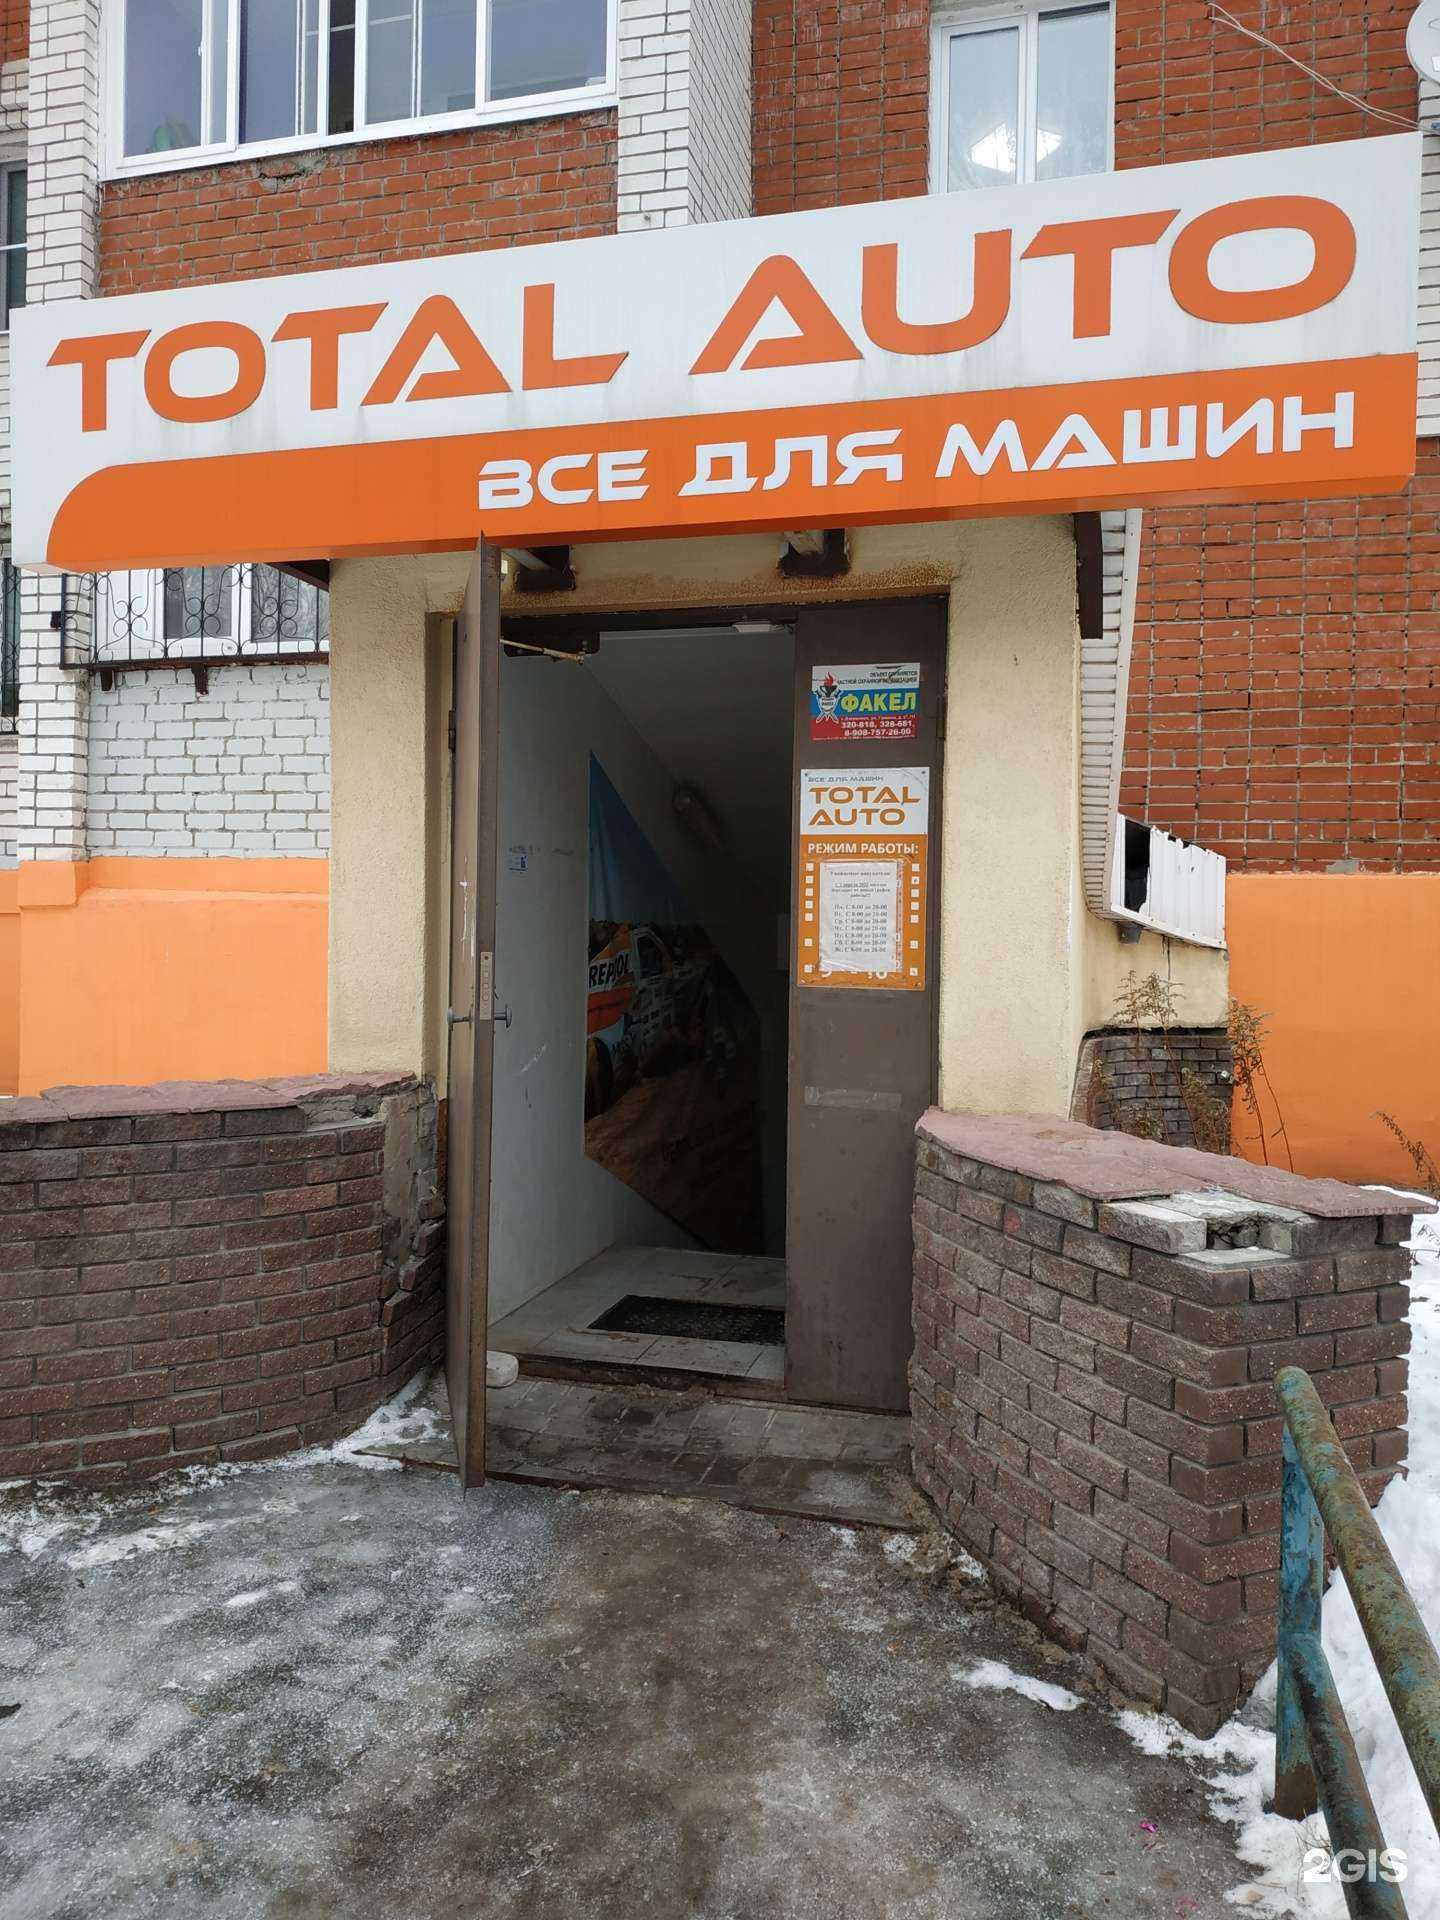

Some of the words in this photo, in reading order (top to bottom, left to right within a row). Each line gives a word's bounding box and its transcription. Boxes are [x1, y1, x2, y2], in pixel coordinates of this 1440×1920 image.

[46, 282, 629, 432] TOTAL
[688, 194, 1357, 376] AUTO
[478, 449, 650, 510] ВСЕ
[677, 428, 904, 496] ДЛЯ
[934, 391, 1355, 479] МАШИН
[841, 692, 917, 712] ФАКЕЛ
[808, 786, 921, 804] TOTAL
[808, 807, 906, 826] AUTO
[808, 843, 857, 854] РЕЖИМ
[860, 843, 919, 854] РАБОТЫ:
